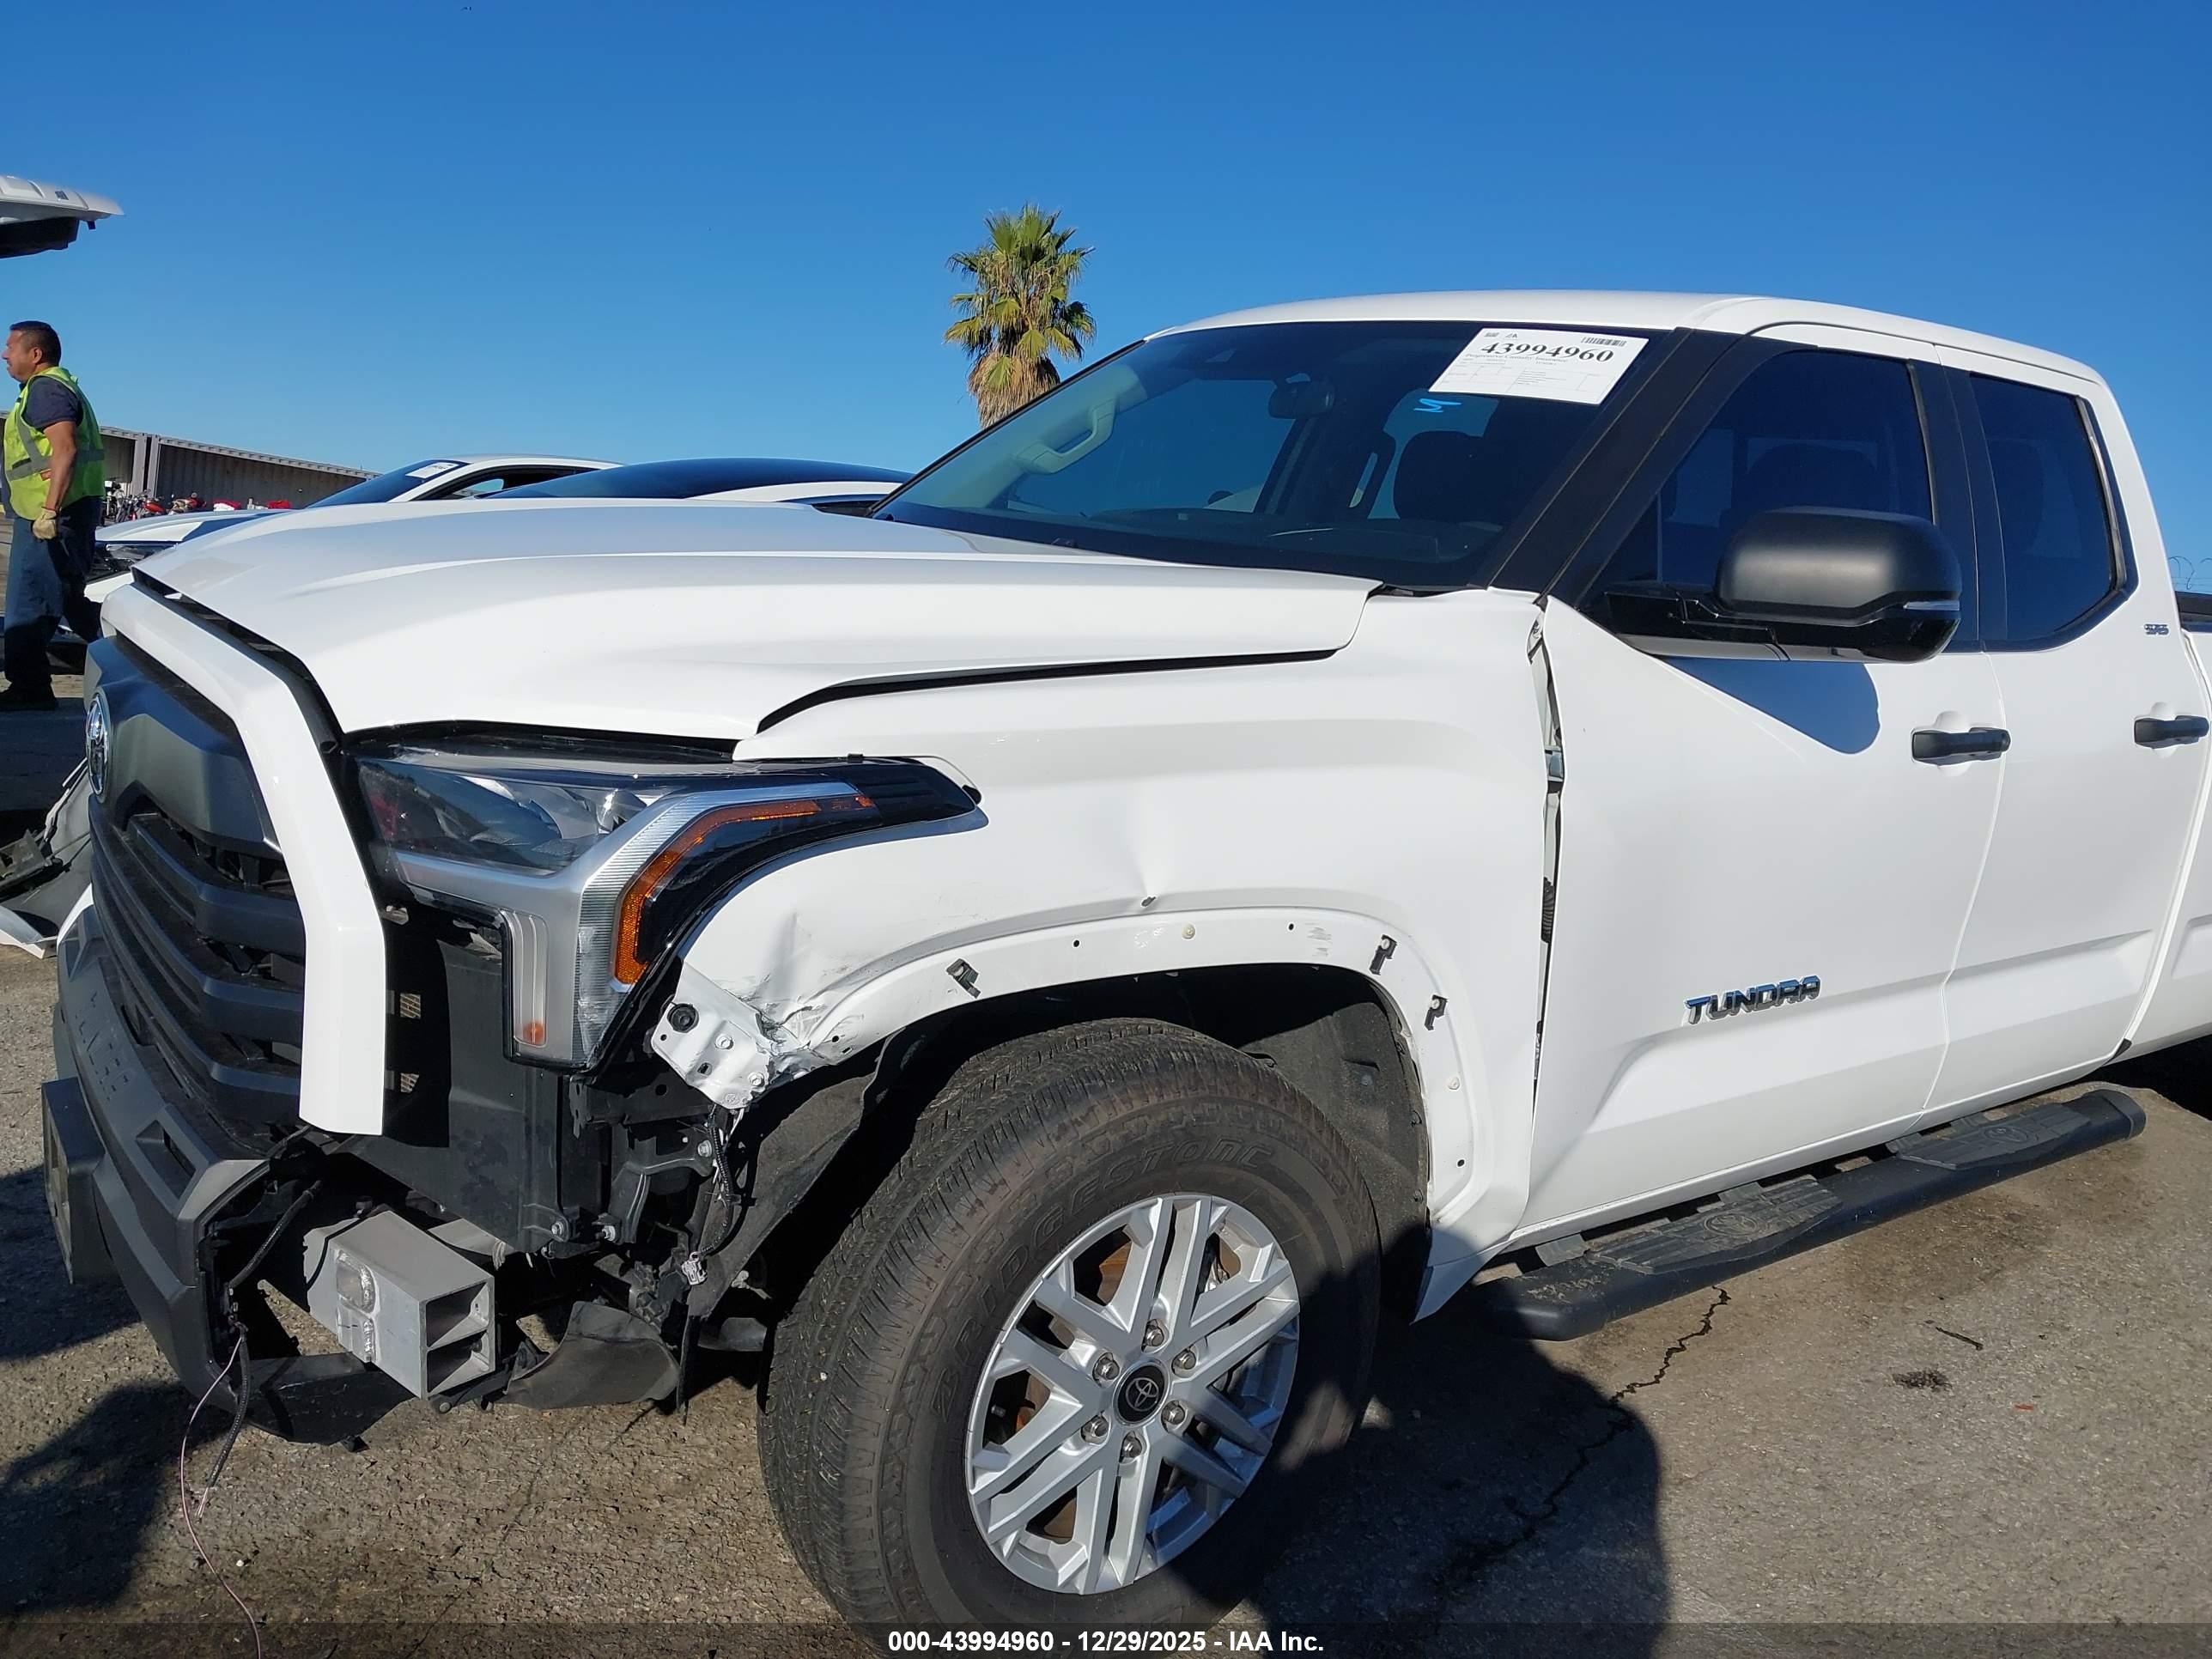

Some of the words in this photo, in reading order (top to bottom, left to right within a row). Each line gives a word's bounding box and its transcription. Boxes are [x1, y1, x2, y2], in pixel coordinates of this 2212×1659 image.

[1480, 342, 1614, 362] 43994960
[1685, 975, 1822, 1024] TUNDRA
[930, 1138, 1273, 1422] BRIDGESTONE
